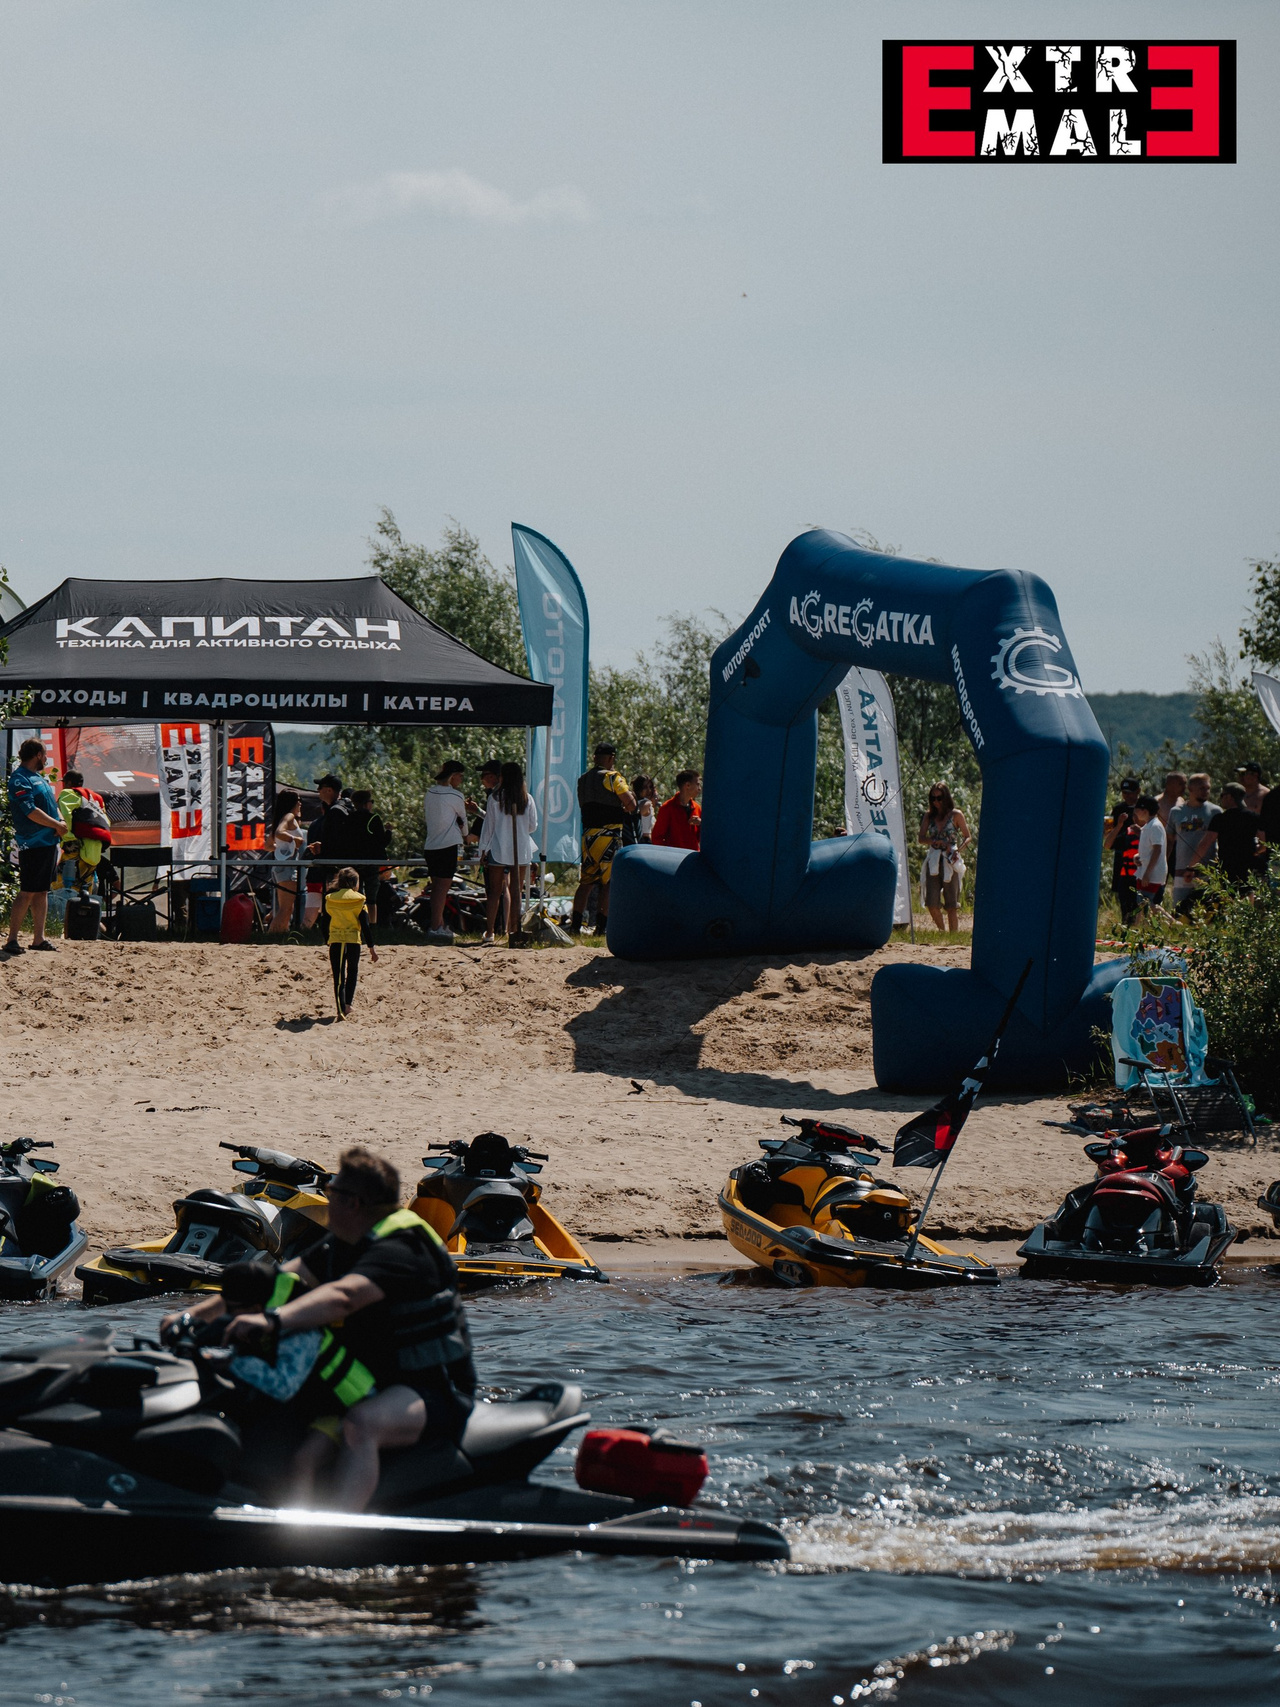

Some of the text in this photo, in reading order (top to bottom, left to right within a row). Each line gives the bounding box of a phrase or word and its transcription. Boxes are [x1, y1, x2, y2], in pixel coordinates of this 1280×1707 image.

[56, 616, 401, 640] КАПИТАН
[789, 589, 935, 648] AGREGATKA
[56, 638, 401, 651] ТЕХНИКА ДЛЯ АКТИВНОГО ОТДЫХА
[722, 608, 771, 683] MOTORSPORT
[164, 692, 348, 708] КВАДРОЦИКЛЫ
[384, 696, 474, 712] КАТЕРА
[950, 644, 985, 751] MOTORSPORT
